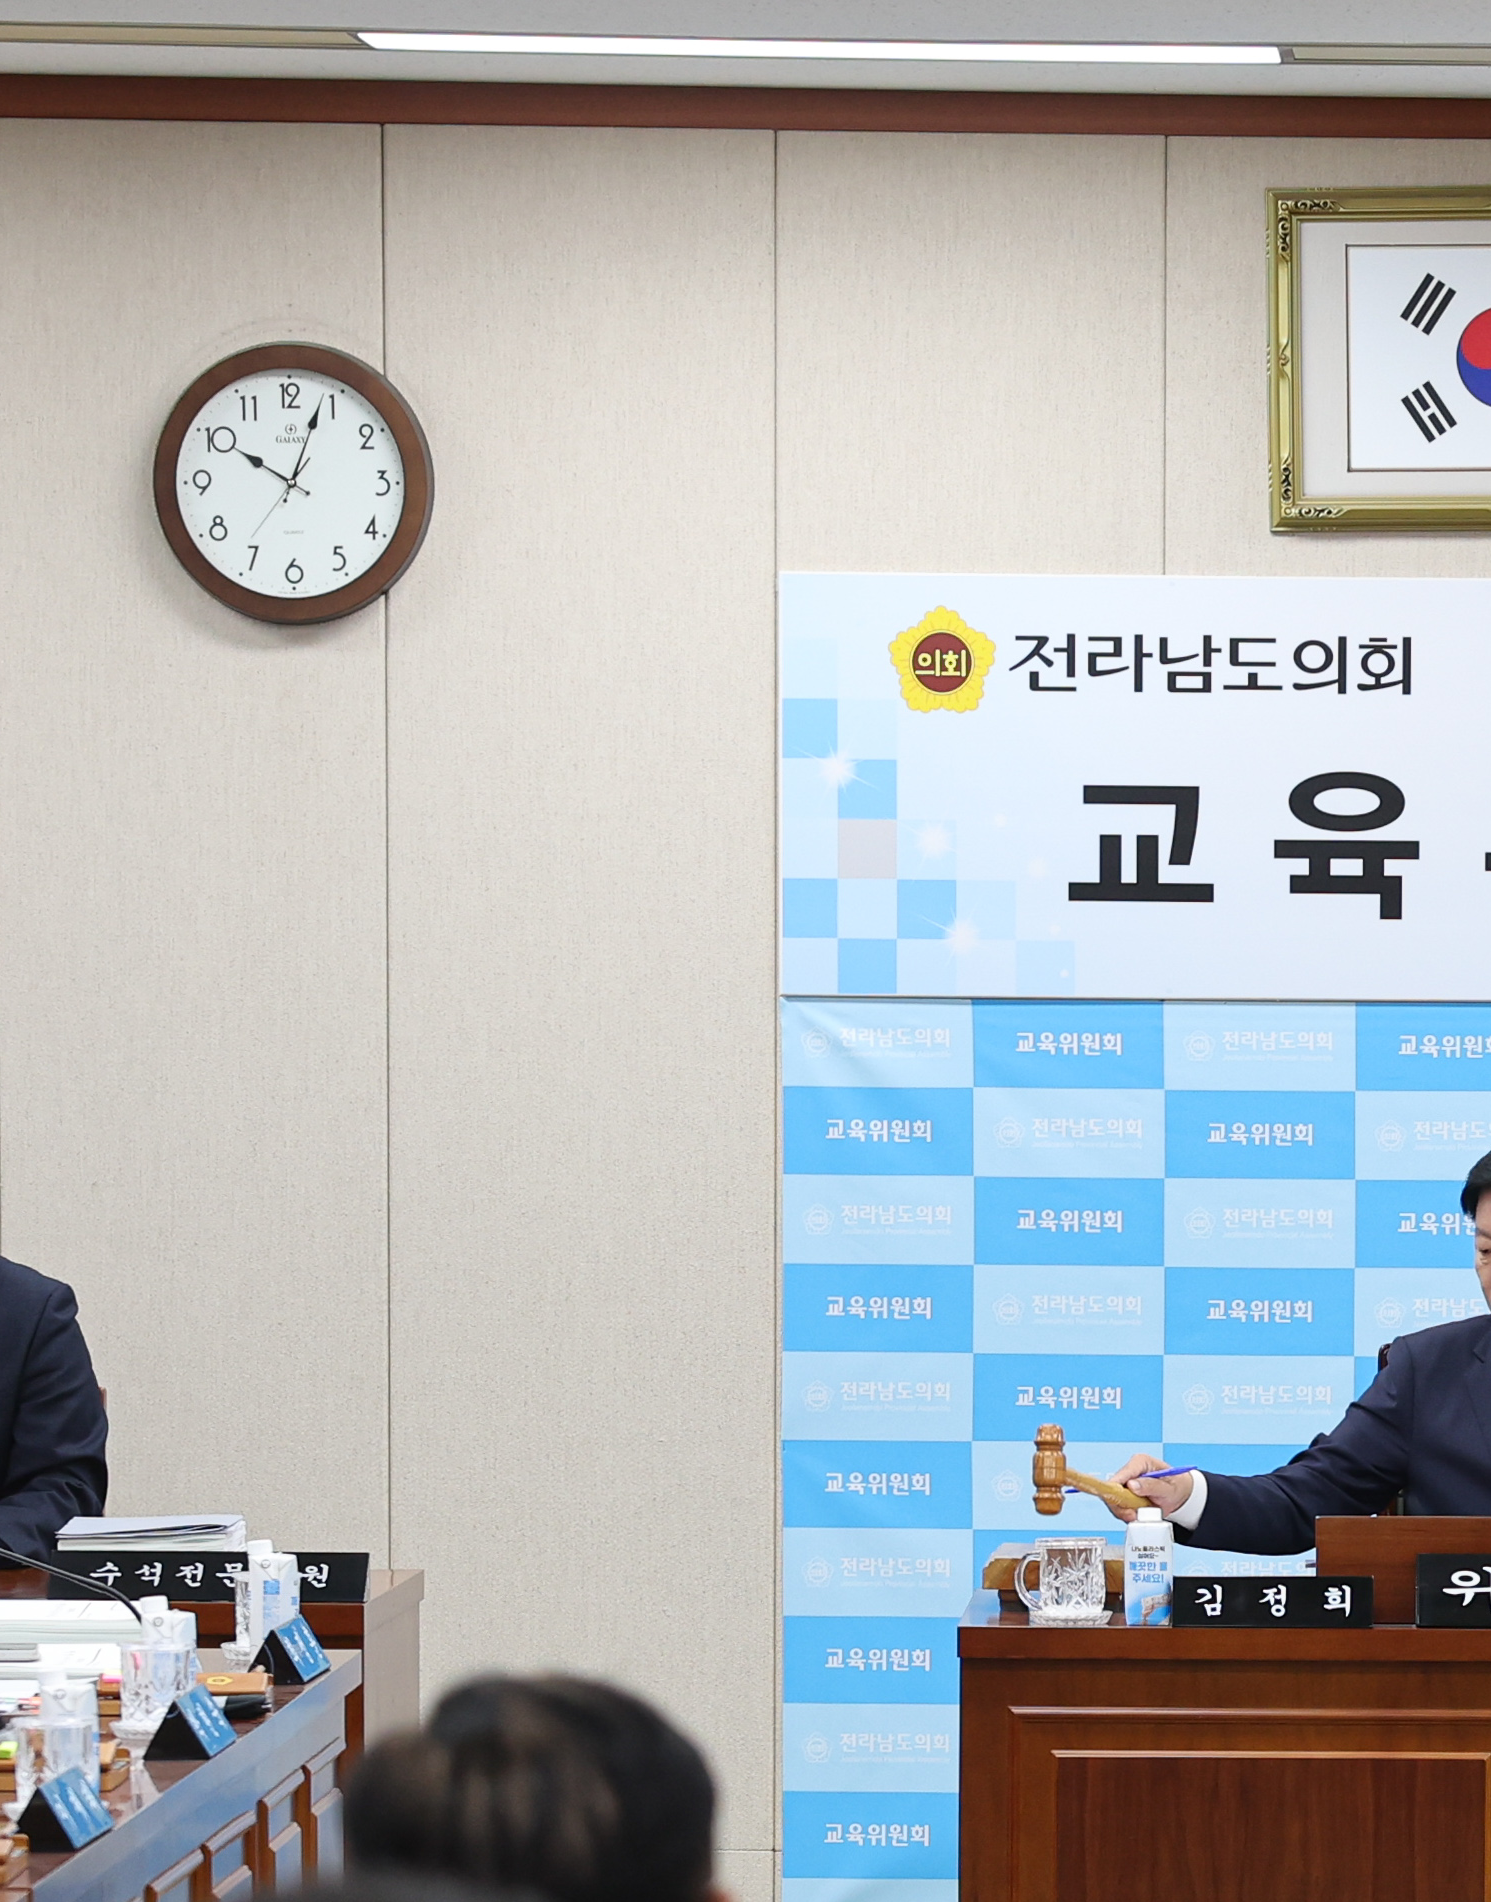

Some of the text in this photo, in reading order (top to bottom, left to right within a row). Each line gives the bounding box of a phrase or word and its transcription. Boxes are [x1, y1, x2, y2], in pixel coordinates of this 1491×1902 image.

[279, 383, 300, 409] 12
[329, 394, 334, 419] 1
[240, 395, 257, 421] 11
[205, 426, 236, 453] 10
[275, 435, 307, 444] GALAXY
[359, 424, 374, 449] 2
[193, 470, 211, 495] 9
[376, 470, 390, 496] 3
[209, 515, 227, 541] 8
[365, 516, 378, 540] 4
[248, 546, 259, 570] 7
[333, 546, 346, 571] 5
[285, 558, 303, 584] 6
[915, 649, 966, 677] 의회
[1009, 634, 1411, 694] 전라남도의회
[841, 1028, 951, 1048] 전라남도의회
[1016, 1032, 1122, 1055] 교육위원회
[1223, 1032, 1333, 1051] 전라남도의회
[826, 1120, 931, 1142] 교육위원회
[1033, 1118, 1142, 1138] 전라남도의회
[1208, 1123, 1313, 1146] 교육위원회
[842, 1205, 951, 1225] 전라남도의회
[1017, 1210, 1122, 1233] 교육위원회
[1223, 1208, 1333, 1228] 전라남도의회
[826, 1296, 931, 1319] 교육위원회
[1033, 1295, 1141, 1315] 전라남도의회
[1207, 1300, 1312, 1323] 교육위원회
[841, 1382, 950, 1401] 전라남도의회
[1016, 1386, 1121, 1409] 교육위원회
[1223, 1385, 1331, 1404] 전라남도의회
[825, 1472, 930, 1495] 교육위원회
[90, 1562, 330, 1588] 수석전문원
[842, 1558, 950, 1578] 전라남도의회
[1132, 1573, 1165, 1583] 주세요!
[1195, 1584, 1351, 1617] 김정희
[825, 1648, 930, 1671] 교육위원회
[841, 1734, 950, 1753] 전라남도의회
[824, 1824, 929, 1846] 교육위원회
